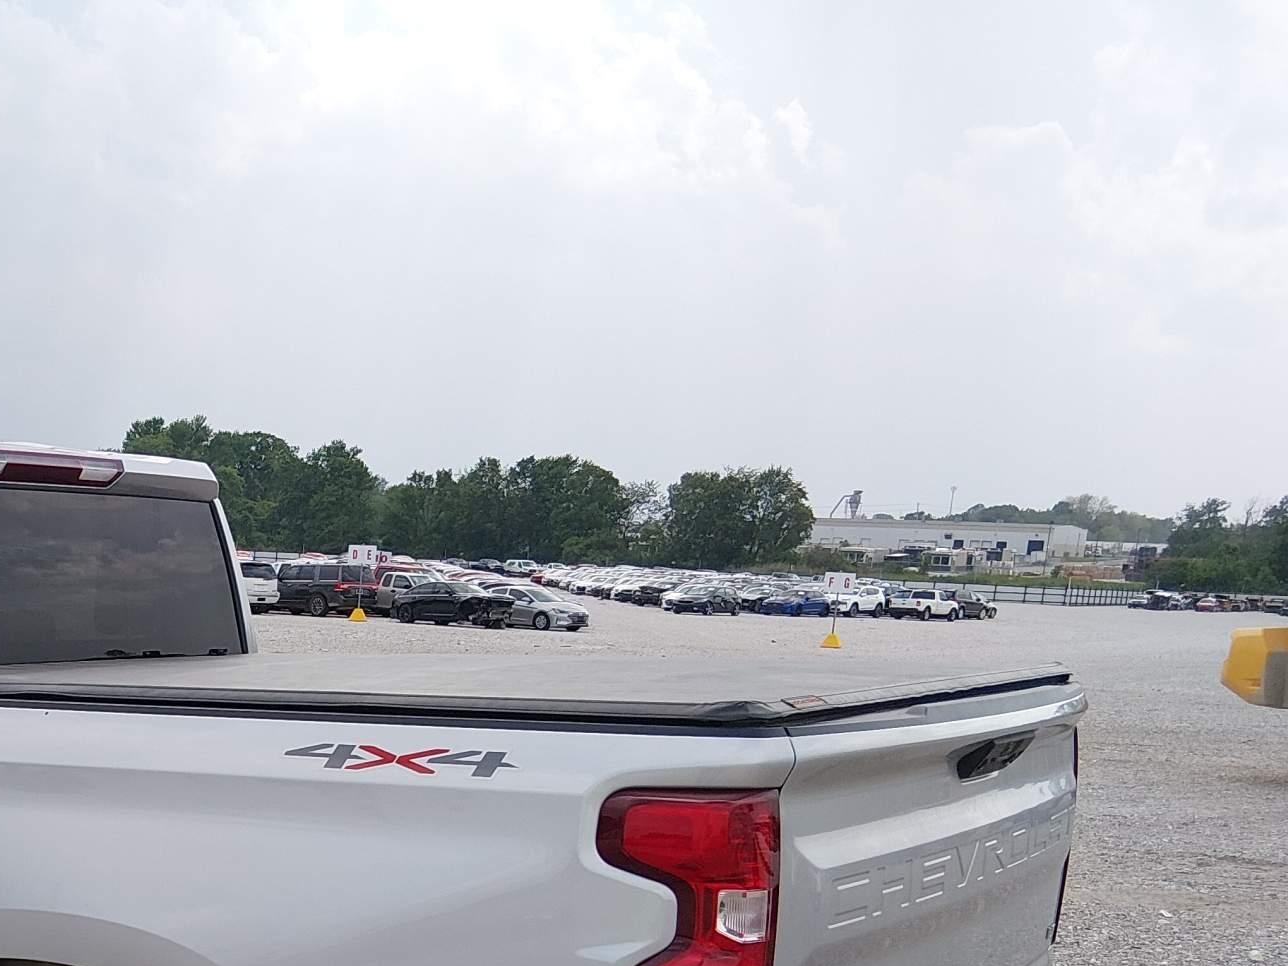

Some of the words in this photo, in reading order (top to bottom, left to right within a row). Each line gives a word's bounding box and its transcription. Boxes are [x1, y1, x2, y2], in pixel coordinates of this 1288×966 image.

[367, 549, 372, 561] E
[828, 576, 835, 588] F
[844, 577, 850, 589] G
[827, 803, 1075, 929] CHEVROLET
